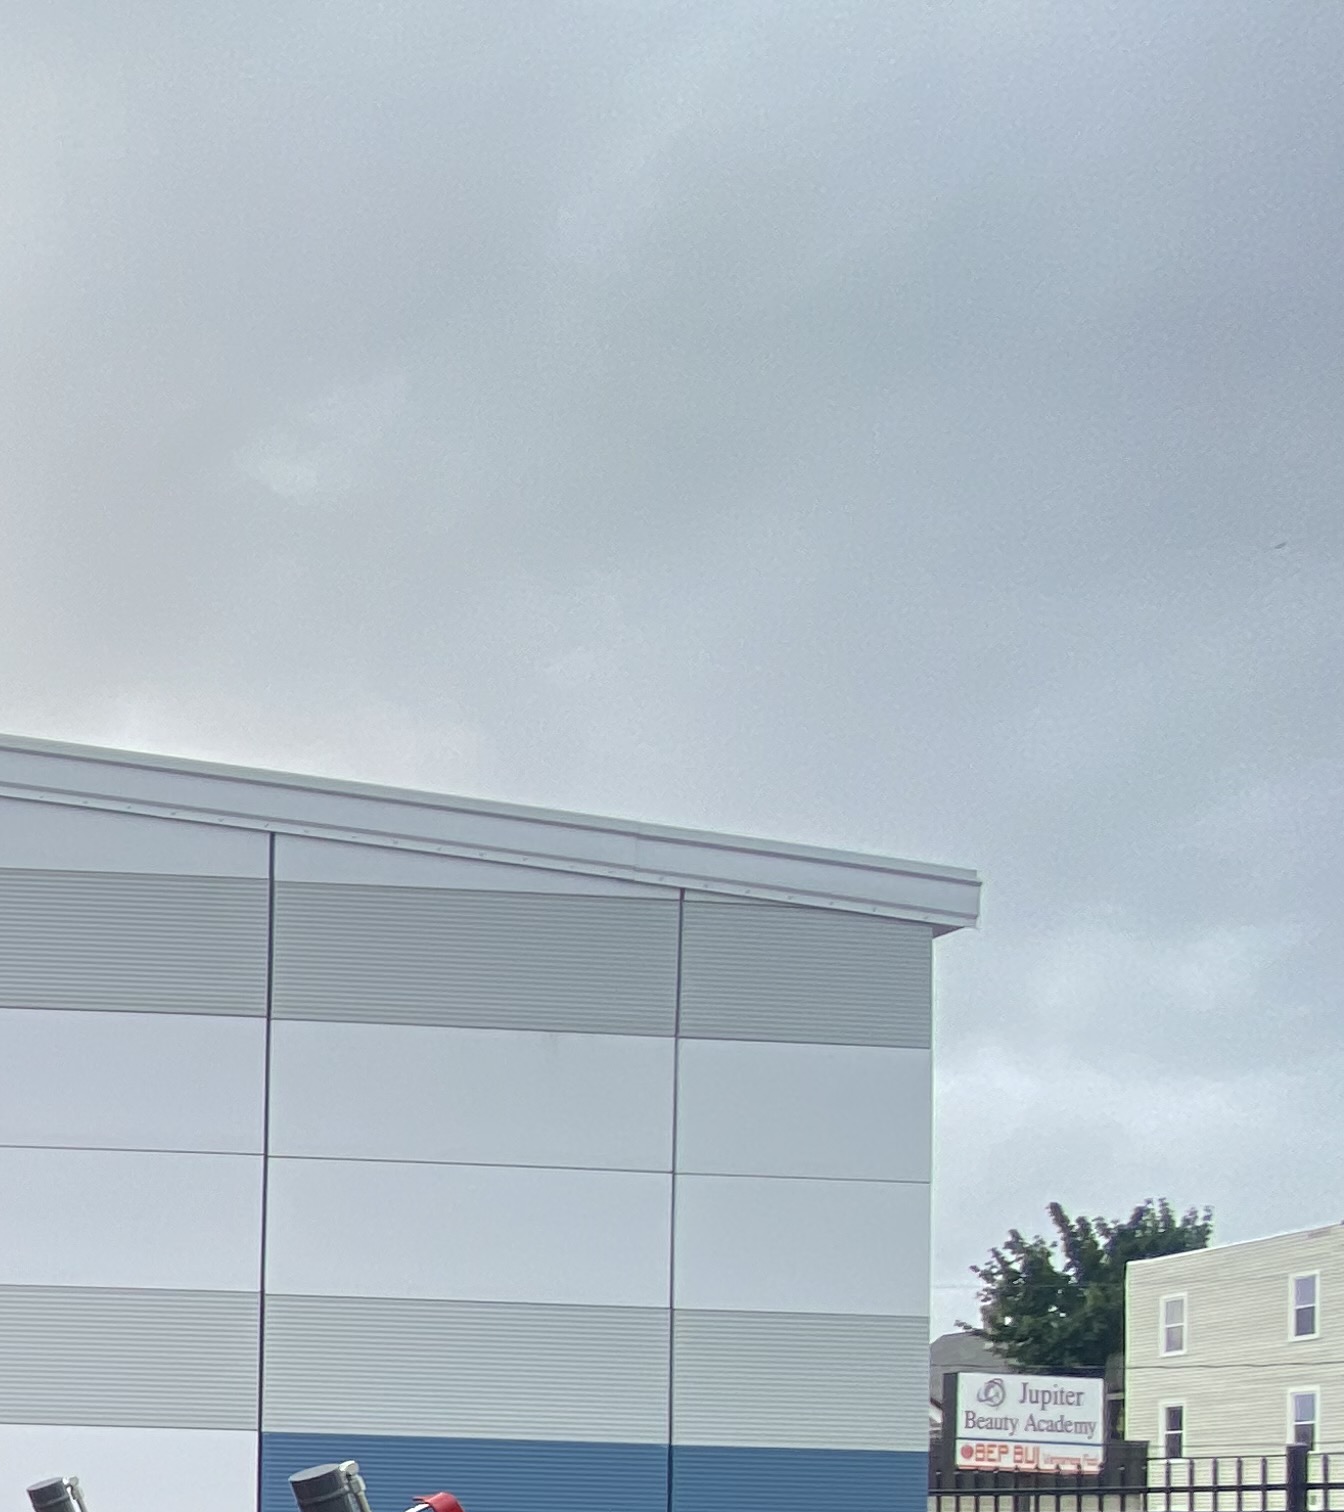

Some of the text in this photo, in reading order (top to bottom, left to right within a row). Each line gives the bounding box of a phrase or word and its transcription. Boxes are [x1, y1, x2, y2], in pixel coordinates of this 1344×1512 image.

[1019, 1382, 1084, 1410] Jupiter
[964, 1410, 1097, 1439] Beauty Academy
